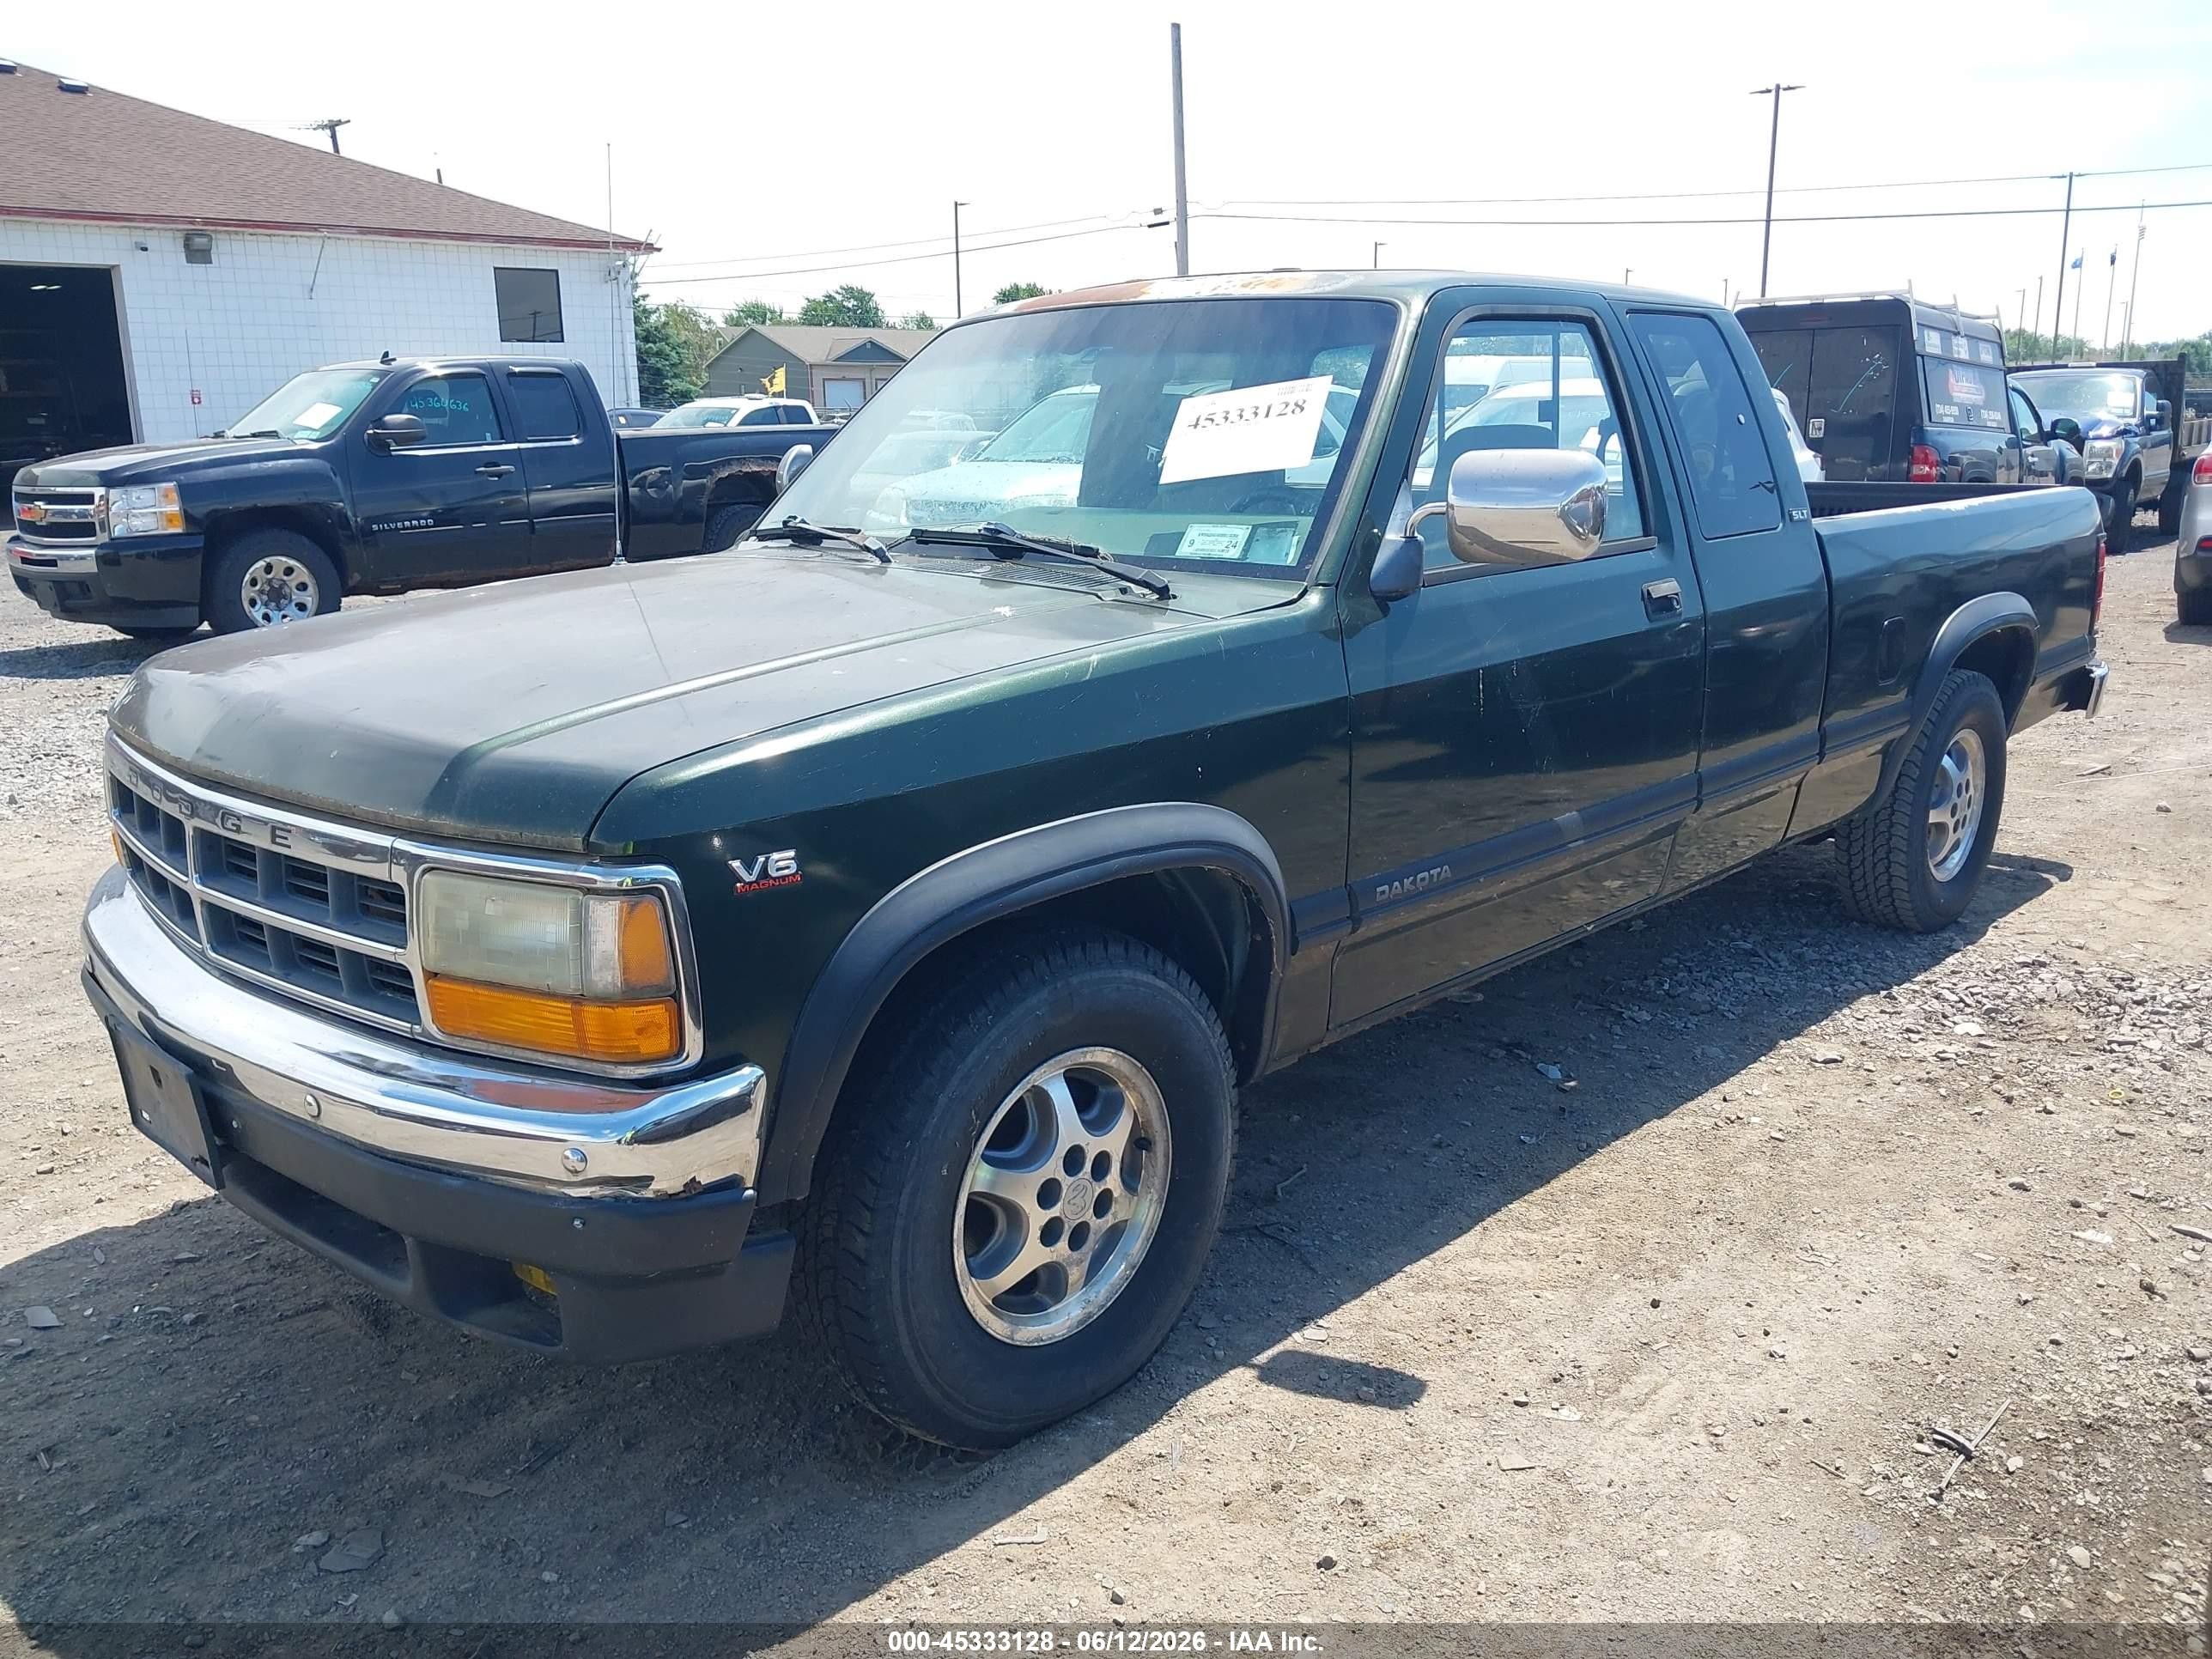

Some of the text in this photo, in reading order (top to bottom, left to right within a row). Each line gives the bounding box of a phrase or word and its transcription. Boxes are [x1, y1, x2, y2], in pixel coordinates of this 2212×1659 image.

[1188, 398, 1306, 429] 45333128
[1792, 510, 1808, 519] SLT
[372, 519, 434, 531] SILVERADO
[1188, 538, 1194, 547] 9
[1225, 540, 1237, 550] 24
[128, 767, 292, 849] DODGE
[728, 848, 797, 883] V6
[736, 874, 802, 893] MAGNUM
[1376, 865, 1451, 902] DAKOTA
